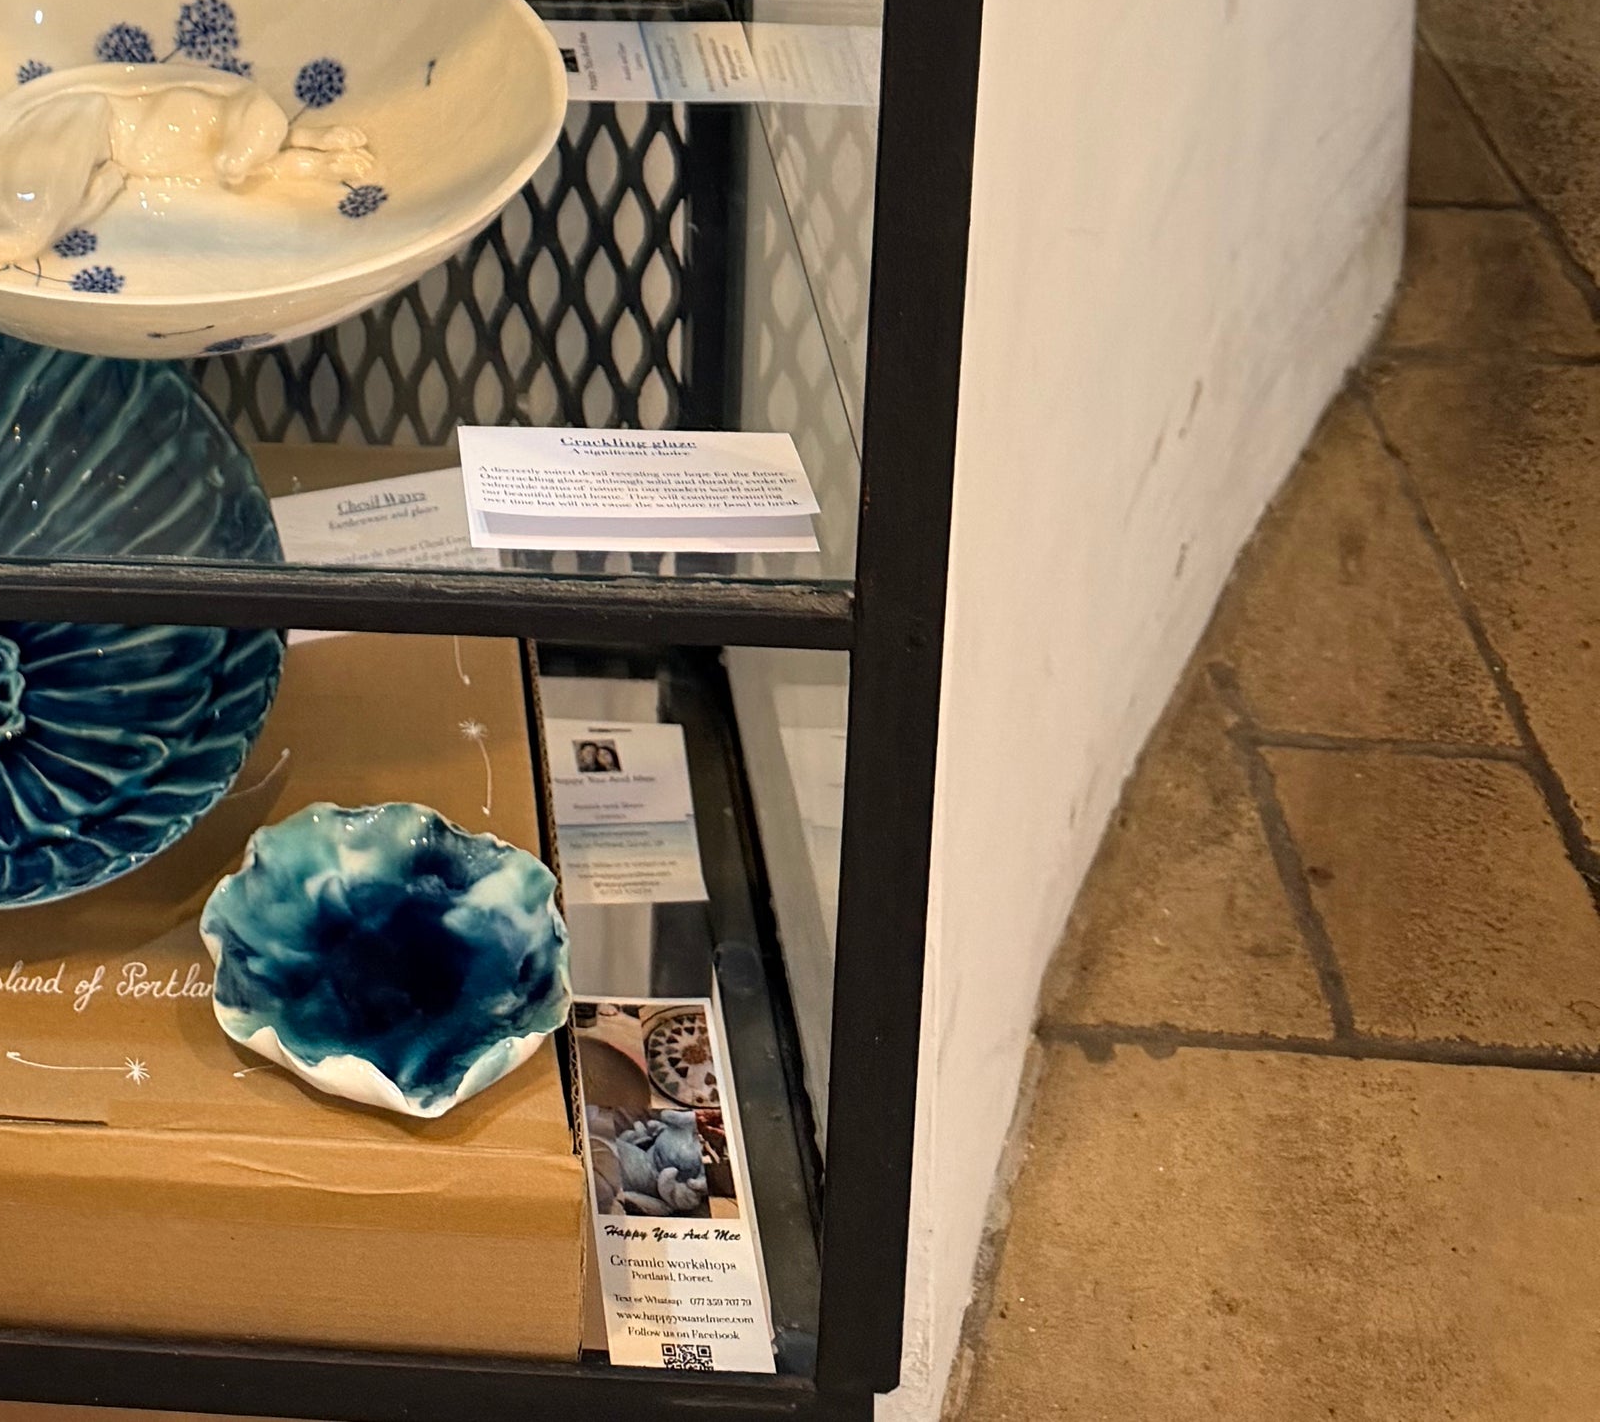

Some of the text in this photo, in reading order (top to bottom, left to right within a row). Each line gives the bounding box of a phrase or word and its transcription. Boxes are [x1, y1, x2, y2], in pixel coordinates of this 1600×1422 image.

[73, 965, 106, 1012] of
[603, 1225, 741, 1242] Happy You And Mee
[609, 1254, 736, 1273] Ceramic workshops
[631, 1270, 713, 1283] Portland, Dorset.
[627, 1326, 740, 1340] Follow us on Facebook
